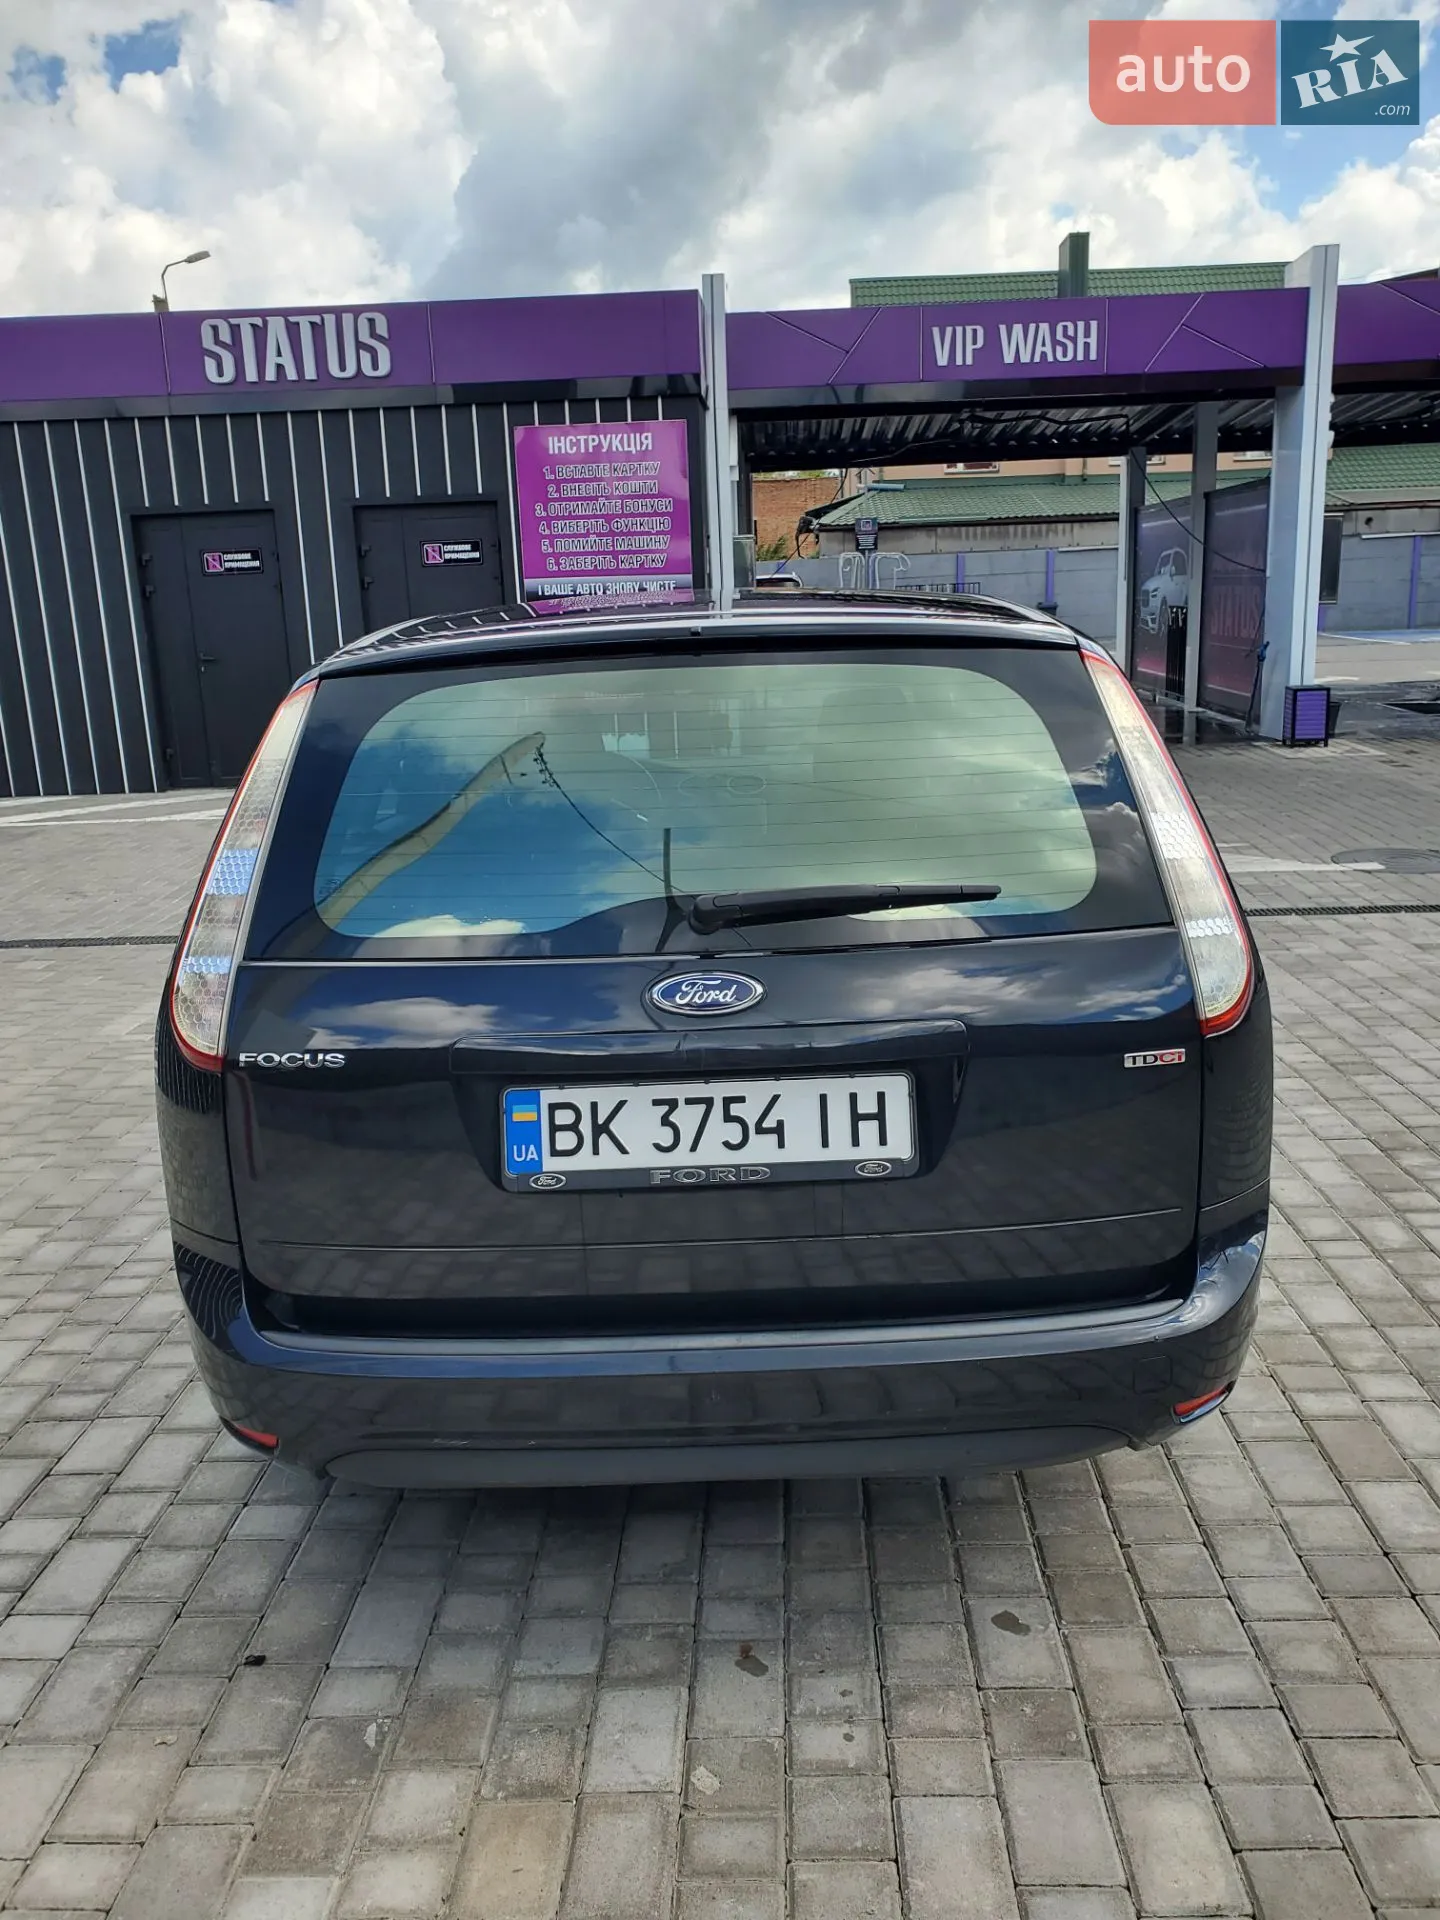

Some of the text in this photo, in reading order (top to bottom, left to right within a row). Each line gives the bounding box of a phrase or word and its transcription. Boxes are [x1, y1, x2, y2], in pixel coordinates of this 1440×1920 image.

[201, 312, 391, 384] STATUS
[932, 320, 1099, 367] VIP WASH
[548, 433, 653, 455] ІНСТРУКЦІЯ
[543, 462, 660, 479] 1. ВСТАВТЕ КАРТКУ
[548, 480, 658, 497] 2. ВНЕСІТЬ КОШТИ
[535, 498, 673, 516] 3. ОТРИМАЙТЕ БОНУСИ
[539, 518, 671, 535] 4. ВИБЕРІТЬ ФУНКЦІЮ
[542, 535, 670, 553] 5. ПОМИЙТЕ МАШИНУ
[547, 554, 667, 571] 6. ЗАБЕРІТЬ КАРТКУ
[544, 583, 574, 596] ВАШЕ
[576, 583, 603, 595] АВТО
[675, 979, 738, 1005] Ford
[239, 1052, 345, 1068] FOCUS
[1126, 1050, 1183, 1066] TDCi
[548, 1091, 889, 1157] BK 3754 IH
[512, 1144, 539, 1162] UA
[650, 1166, 771, 1184] FORD
